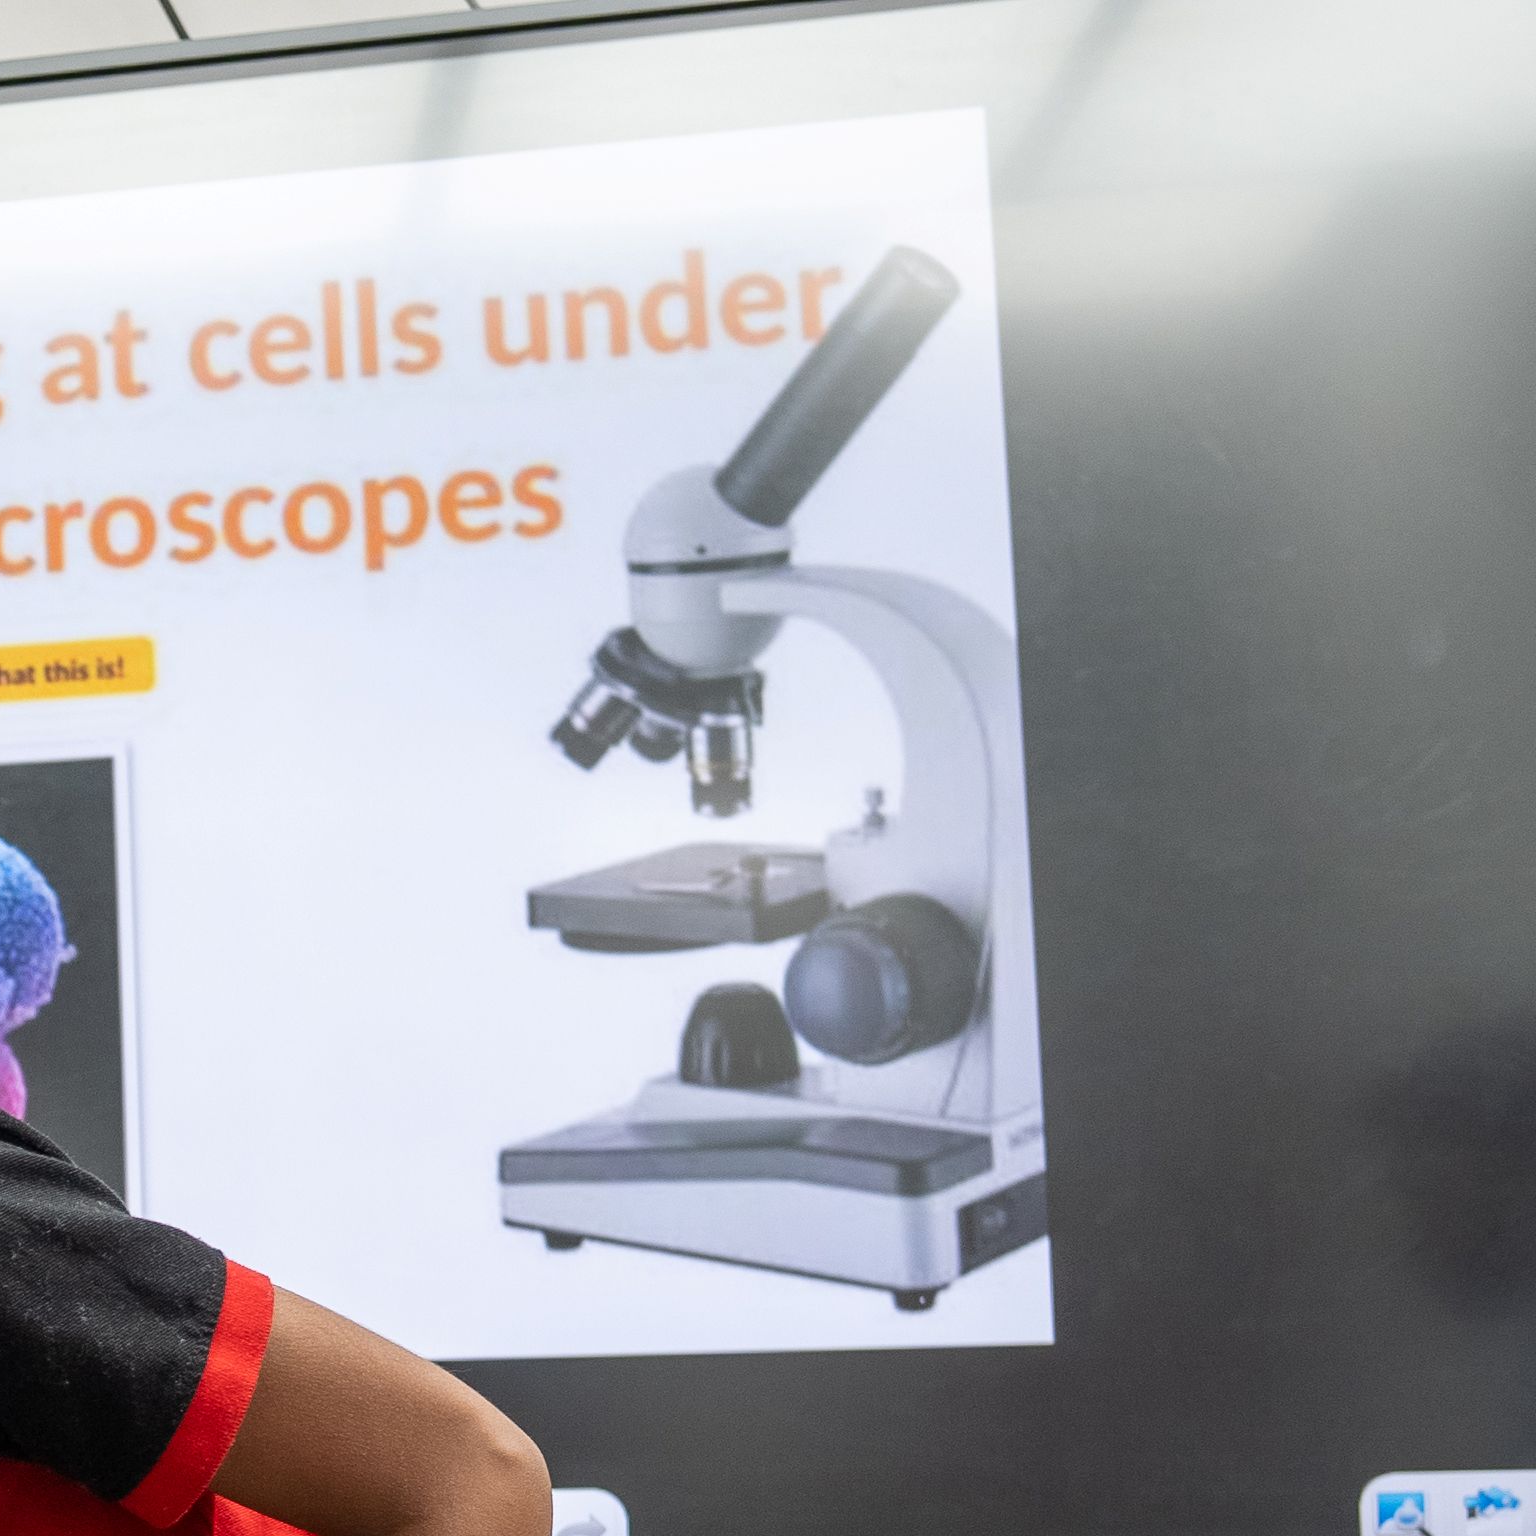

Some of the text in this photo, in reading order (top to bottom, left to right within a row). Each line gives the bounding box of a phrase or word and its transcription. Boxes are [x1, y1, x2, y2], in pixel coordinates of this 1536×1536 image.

[41, 309, 150, 404] at
[188, 277, 444, 391] cells
[483, 248, 842, 366] under
[43, 659, 89, 683] this
[96, 656, 125, 680] is!
